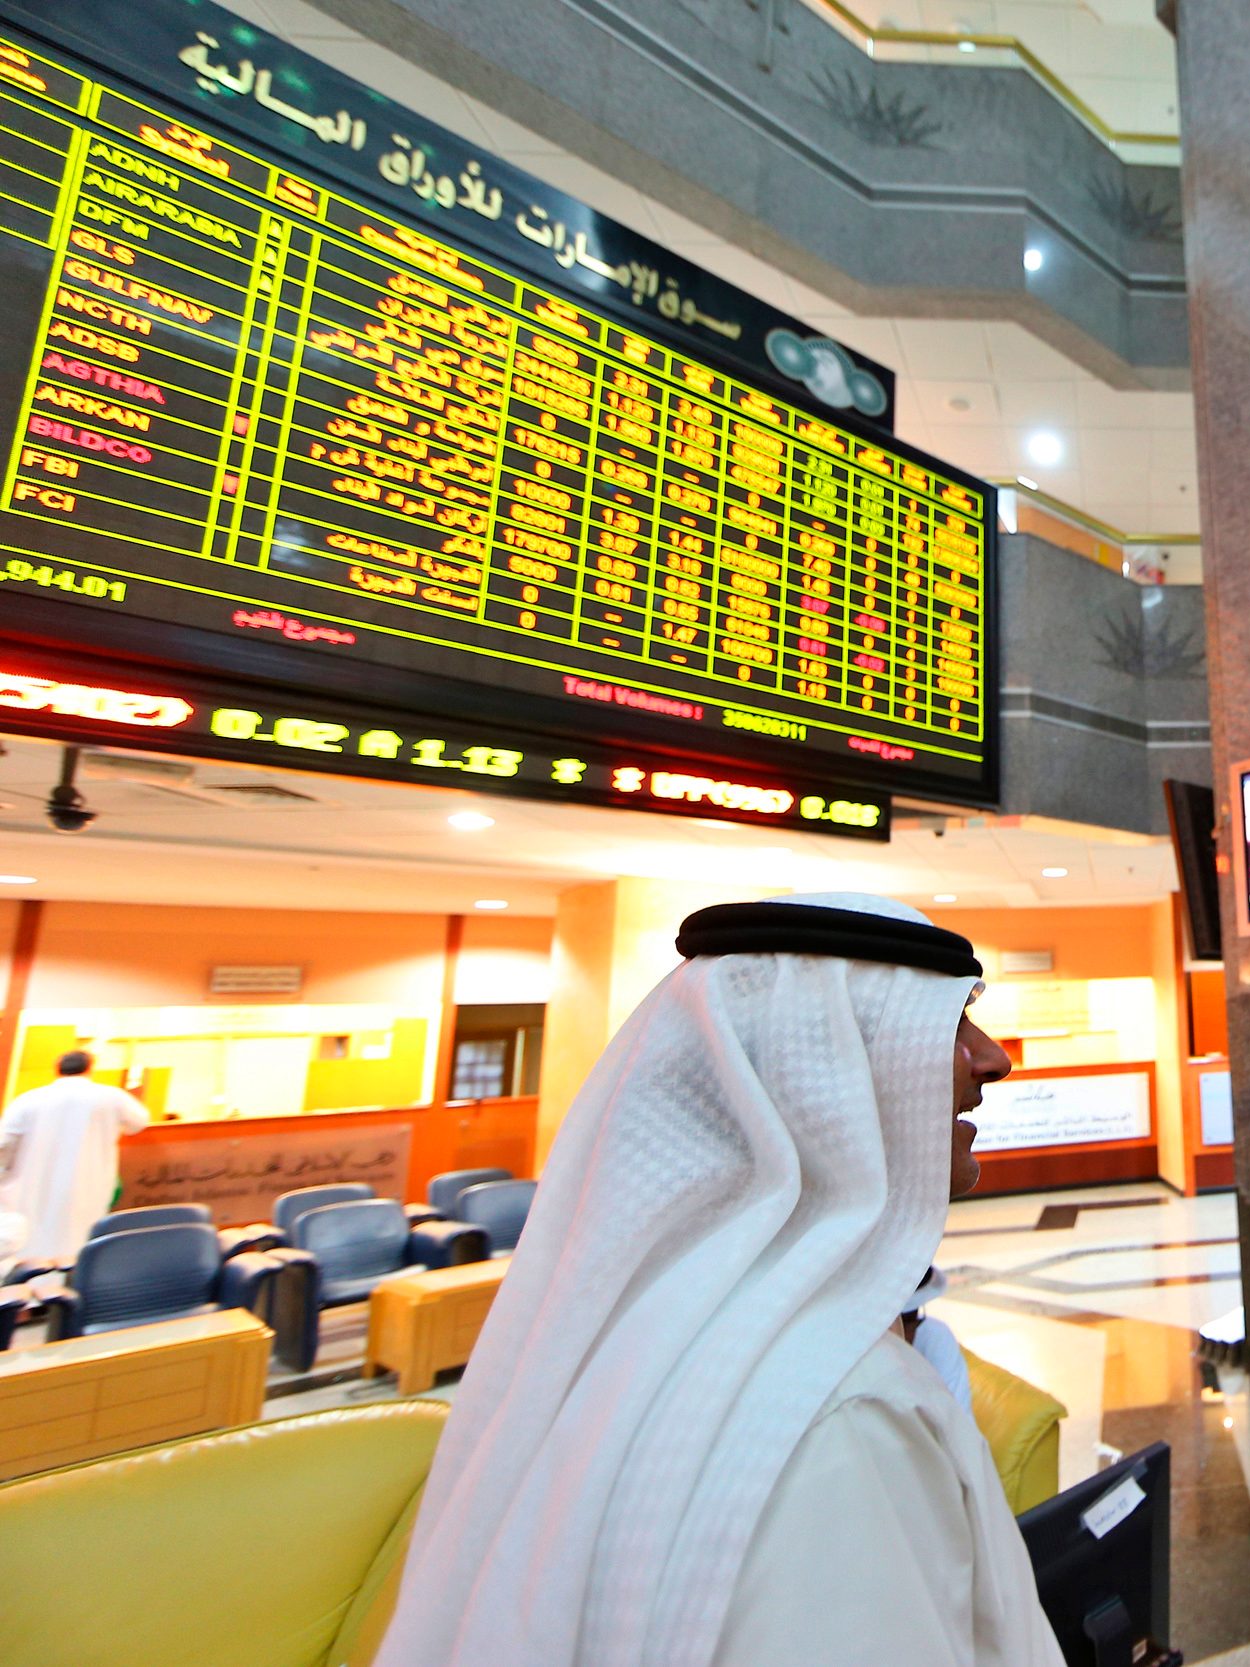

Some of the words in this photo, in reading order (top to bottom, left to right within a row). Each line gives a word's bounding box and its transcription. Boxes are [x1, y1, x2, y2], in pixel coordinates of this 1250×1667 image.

[179, 31, 366, 151] المالية
[88, 143, 180, 192] ADNH
[379, 133, 501, 220] للأوراق
[77, 198, 149, 240] DFM
[82, 171, 242, 249] AIRARABIA
[69, 229, 136, 265] GLS
[516, 206, 658, 305] الإمارات
[56, 288, 152, 335] NCTH
[63, 259, 212, 324] GULFNAV
[658, 277, 741, 340] سوق
[50, 321, 140, 363] ADSB
[43, 352, 166, 405] AGTHIA
[36, 384, 151, 432] ARKAN
[538, 411, 557, 432] 0
[30, 415, 153, 464] BILDCO
[23, 448, 79, 478] FBI
[534, 459, 552, 479] 0
[16, 482, 76, 512] FCI
[512, 478, 572, 511] 10000
[501, 527, 572, 561] 179700
[521, 584, 539, 604] 0
[518, 610, 537, 629] 0
[737, 664, 751, 682] 0
